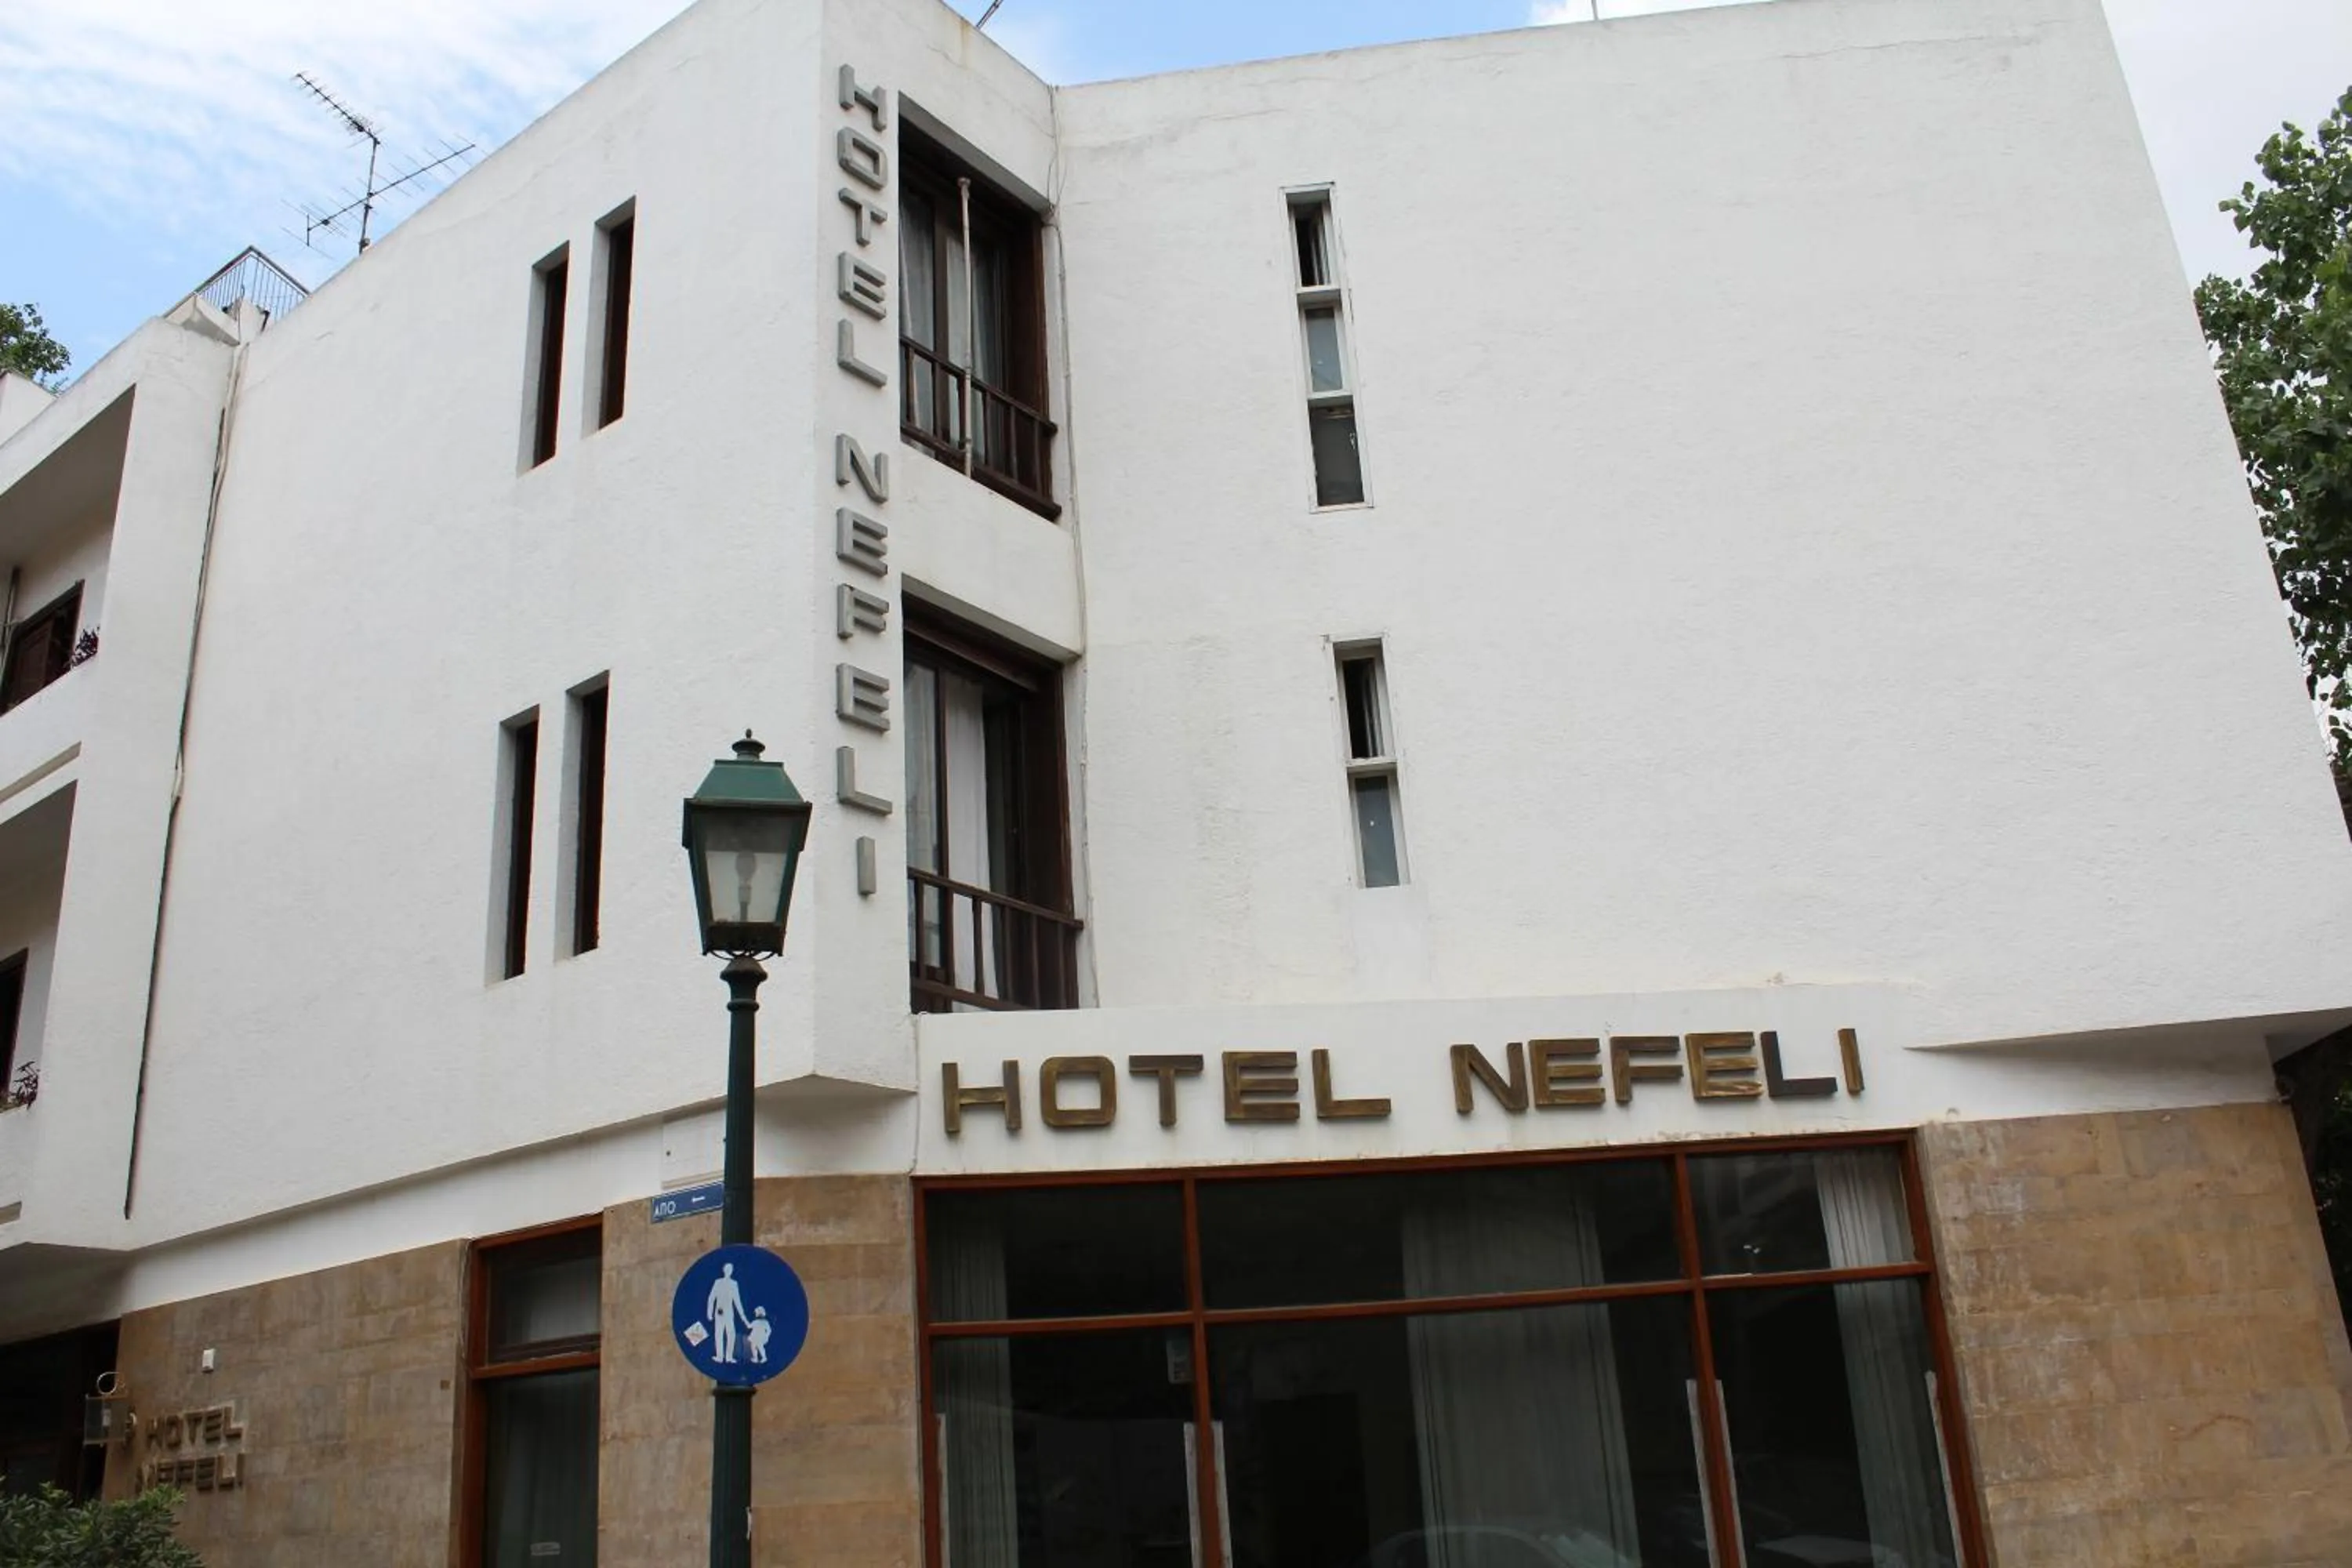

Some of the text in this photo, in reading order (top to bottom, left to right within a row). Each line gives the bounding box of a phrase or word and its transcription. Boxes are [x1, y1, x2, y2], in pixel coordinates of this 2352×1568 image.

[836, 64, 892, 896] HOTEL NEFELI
[942, 1028, 1865, 1134] HOTEL NEFELI
[146, 1406, 242, 1450] HOTEL
[135, 1453, 246, 1494] NEFELI
